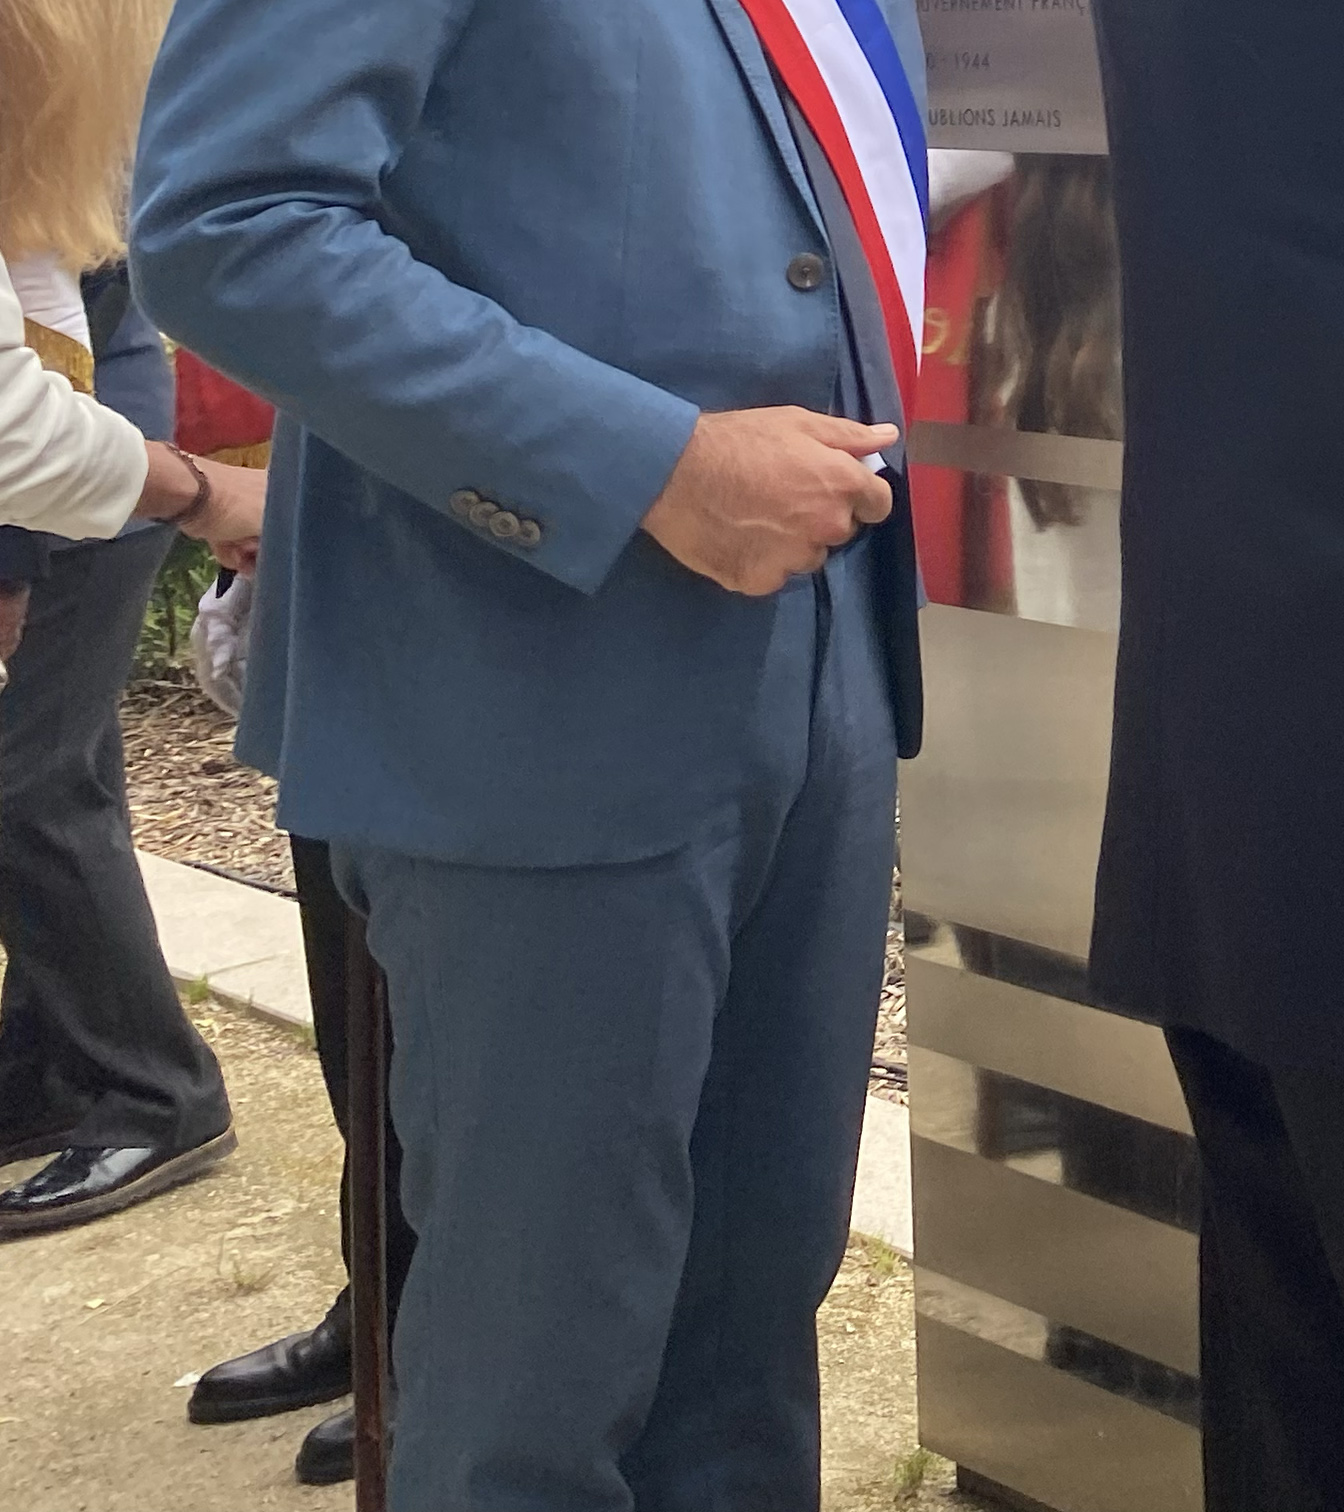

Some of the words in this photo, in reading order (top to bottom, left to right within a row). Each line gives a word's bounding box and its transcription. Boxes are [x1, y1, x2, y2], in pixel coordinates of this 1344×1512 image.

[954, 52, 990, 70] 1944
[928, 108, 995, 126] UBLIONS
[1002, 109, 1062, 128] JAMAIS
